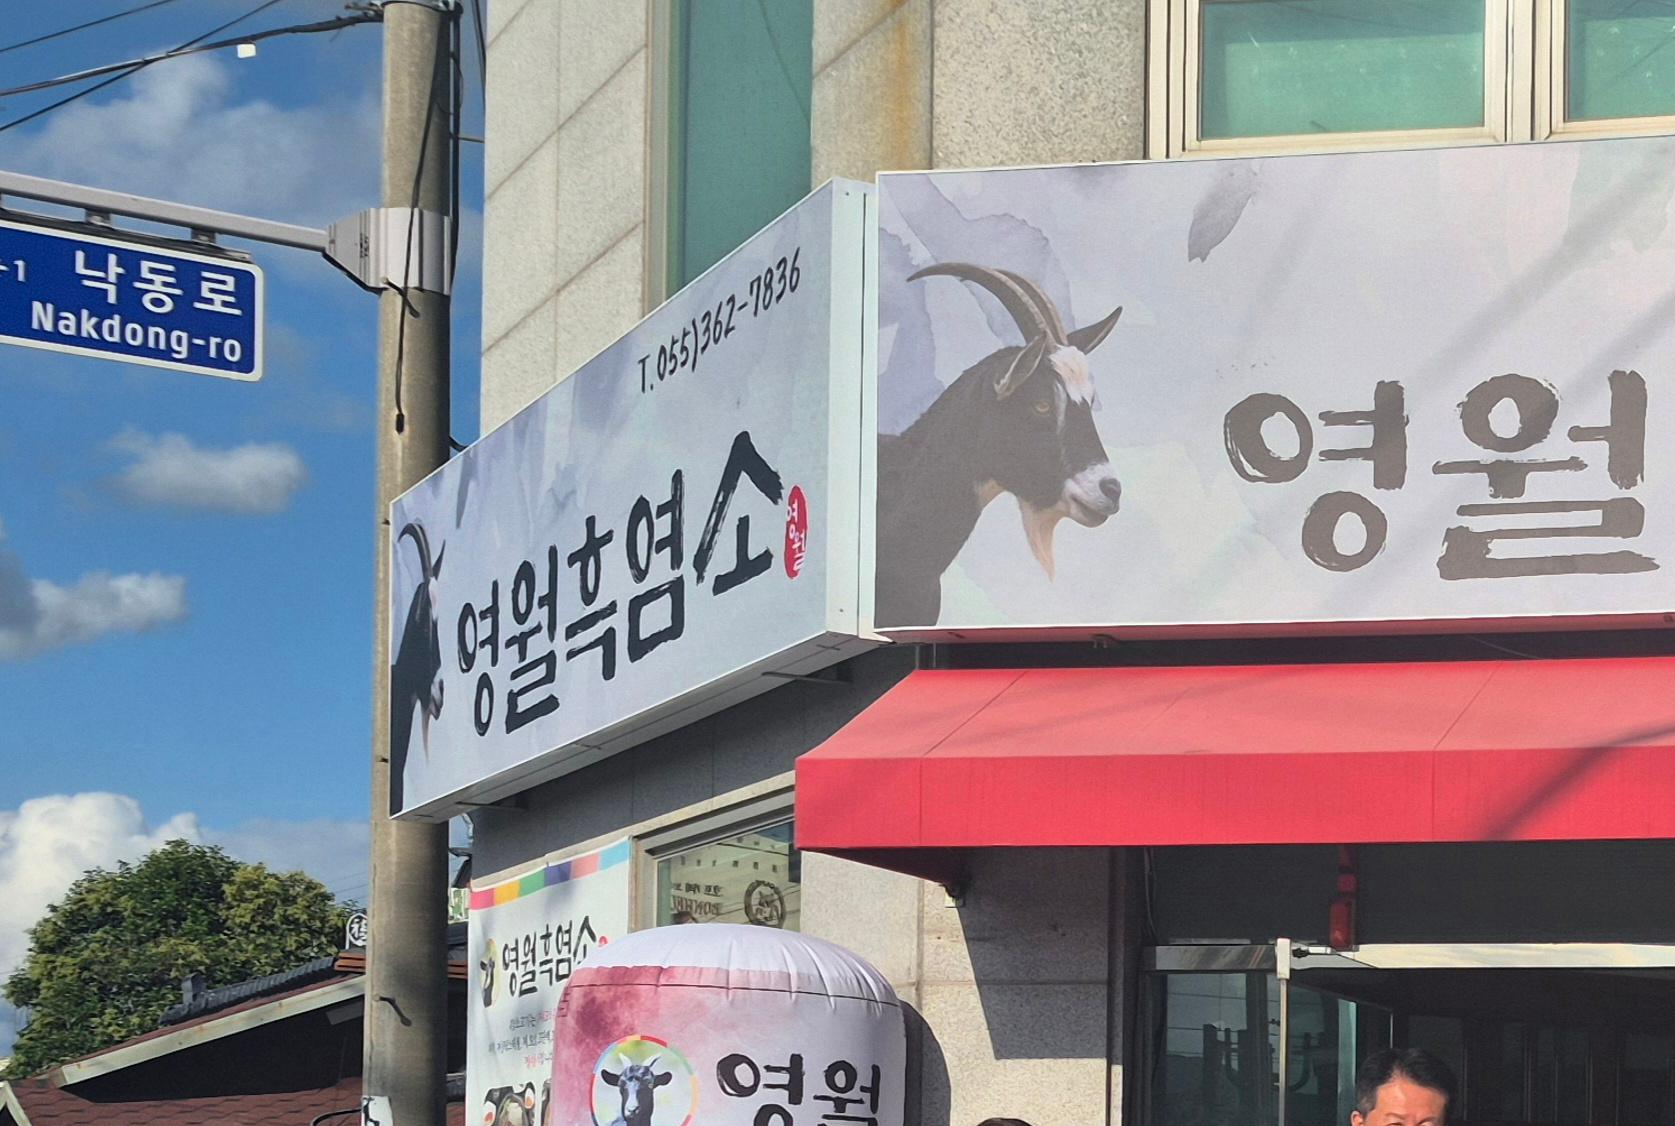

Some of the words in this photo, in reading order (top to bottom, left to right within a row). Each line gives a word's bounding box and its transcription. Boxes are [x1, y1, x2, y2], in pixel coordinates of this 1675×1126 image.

[31, 300, 242, 362] Nakdong-ro
[75, 250, 242, 316] 낙동로
[638, 247, 800, 393] T.055)362-7836
[458, 430, 784, 737] 영월흑염소
